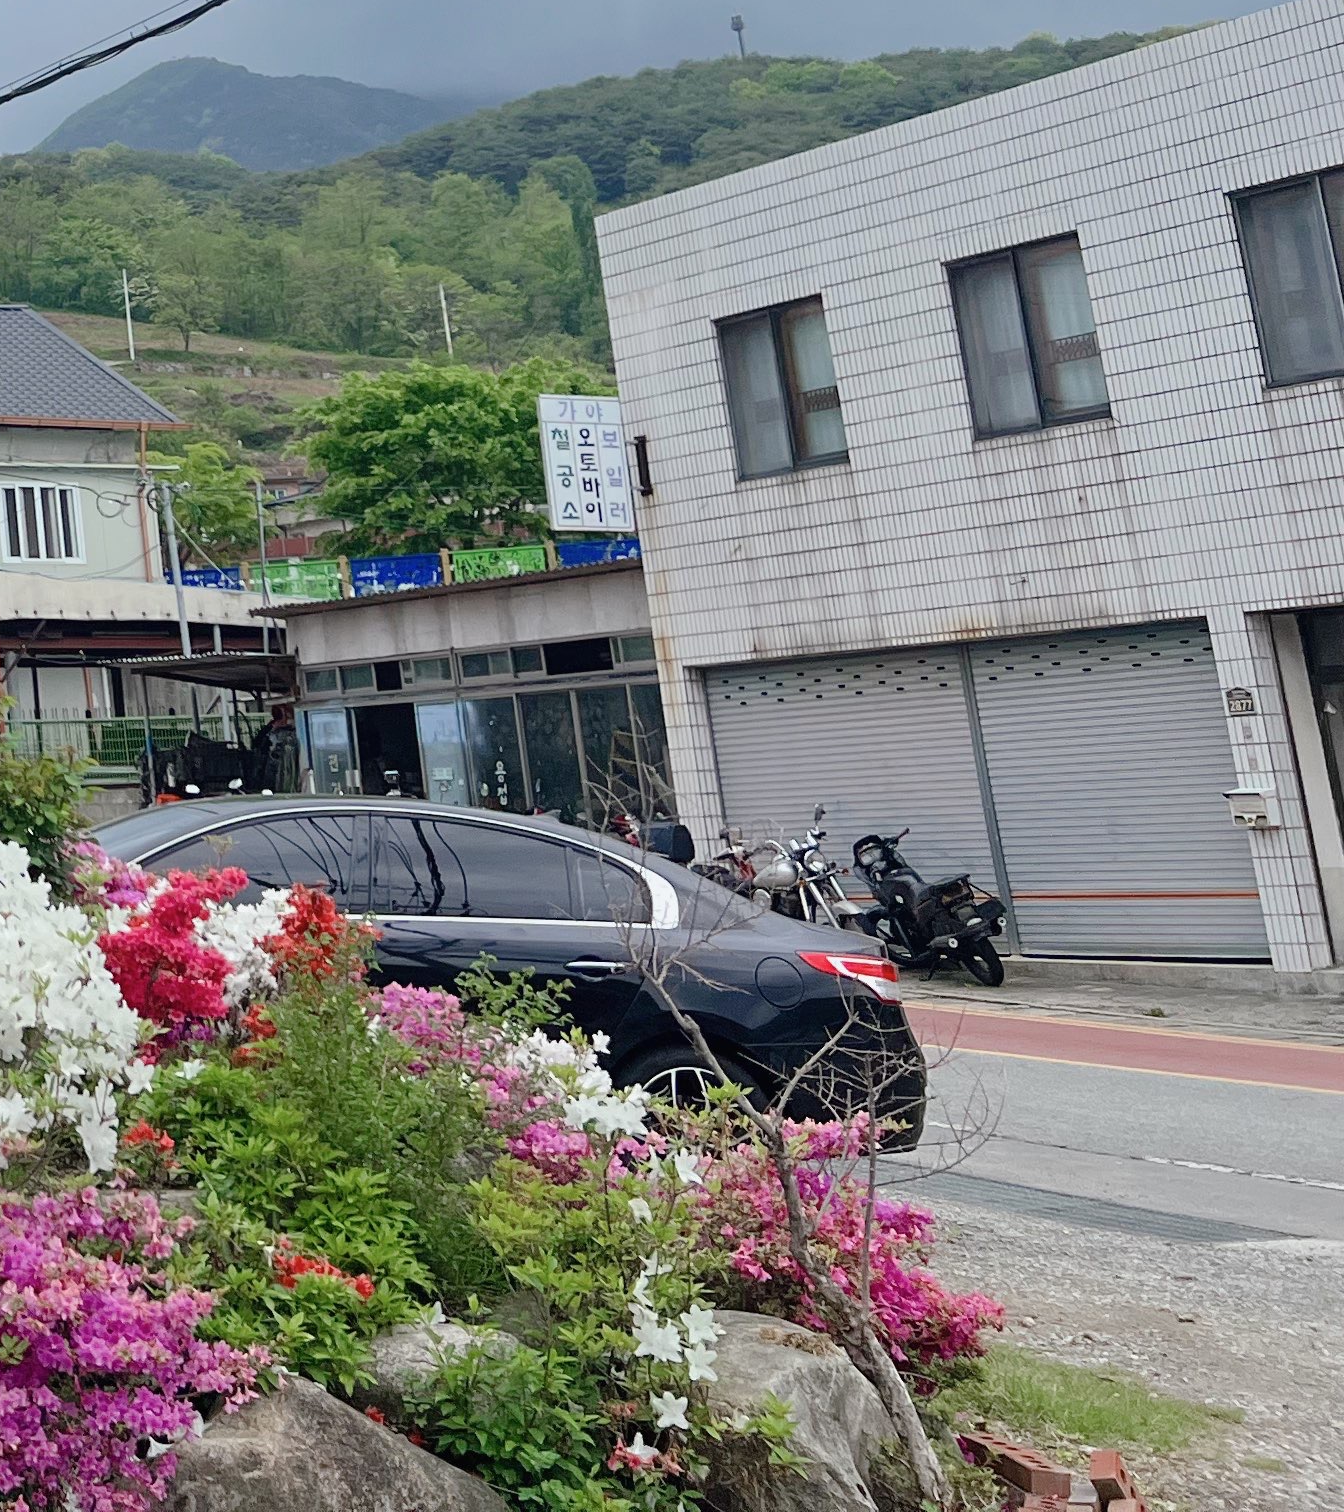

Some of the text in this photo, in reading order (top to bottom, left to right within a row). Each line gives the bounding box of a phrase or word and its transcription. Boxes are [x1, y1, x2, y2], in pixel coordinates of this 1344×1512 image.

[558, 400, 604, 423] 가야
[551, 427, 580, 520] 철공소
[577, 428, 603, 523] 오토바이
[601, 430, 627, 524] 보일러
[1228, 699, 1253, 711] 2877
